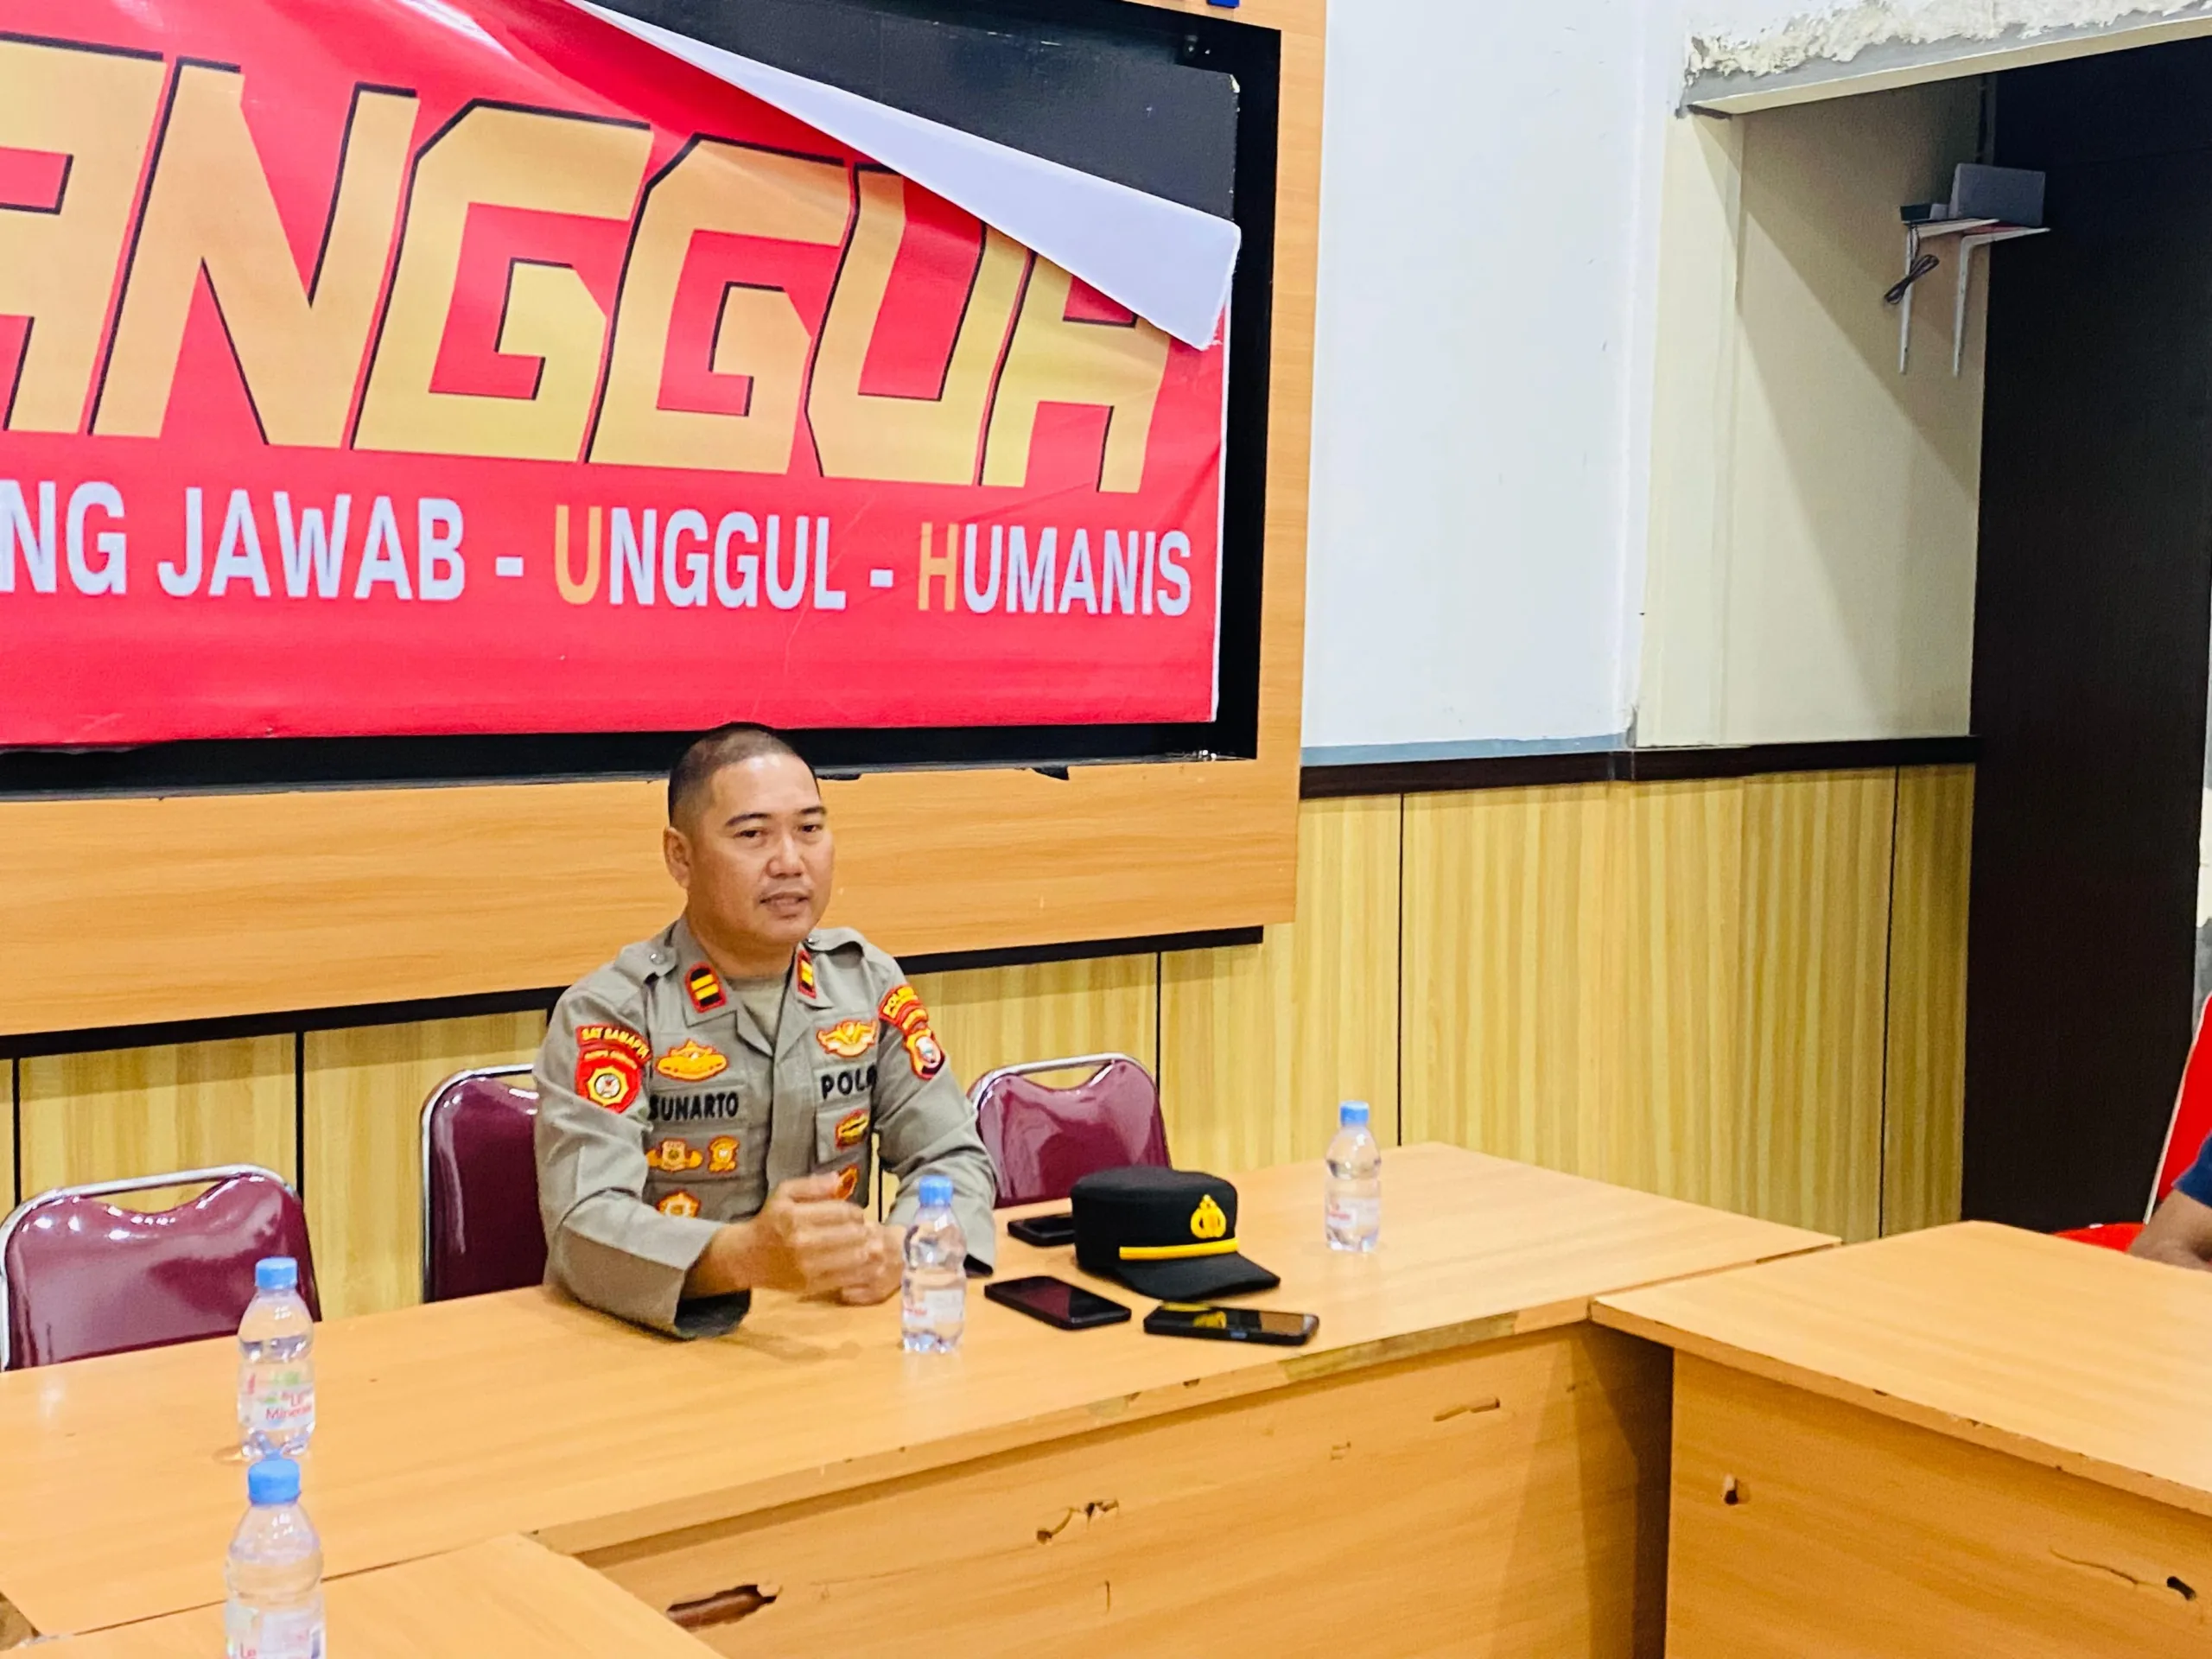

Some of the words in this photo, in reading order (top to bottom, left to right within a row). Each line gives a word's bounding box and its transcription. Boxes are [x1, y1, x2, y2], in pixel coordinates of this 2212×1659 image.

[0, 480, 127, 596] NG
[158, 486, 466, 601] JAWAB
[555, 505, 846, 611] UNGGUL
[918, 523, 1192, 617] HUMANIS
[647, 1091, 740, 1122] SUNARTO
